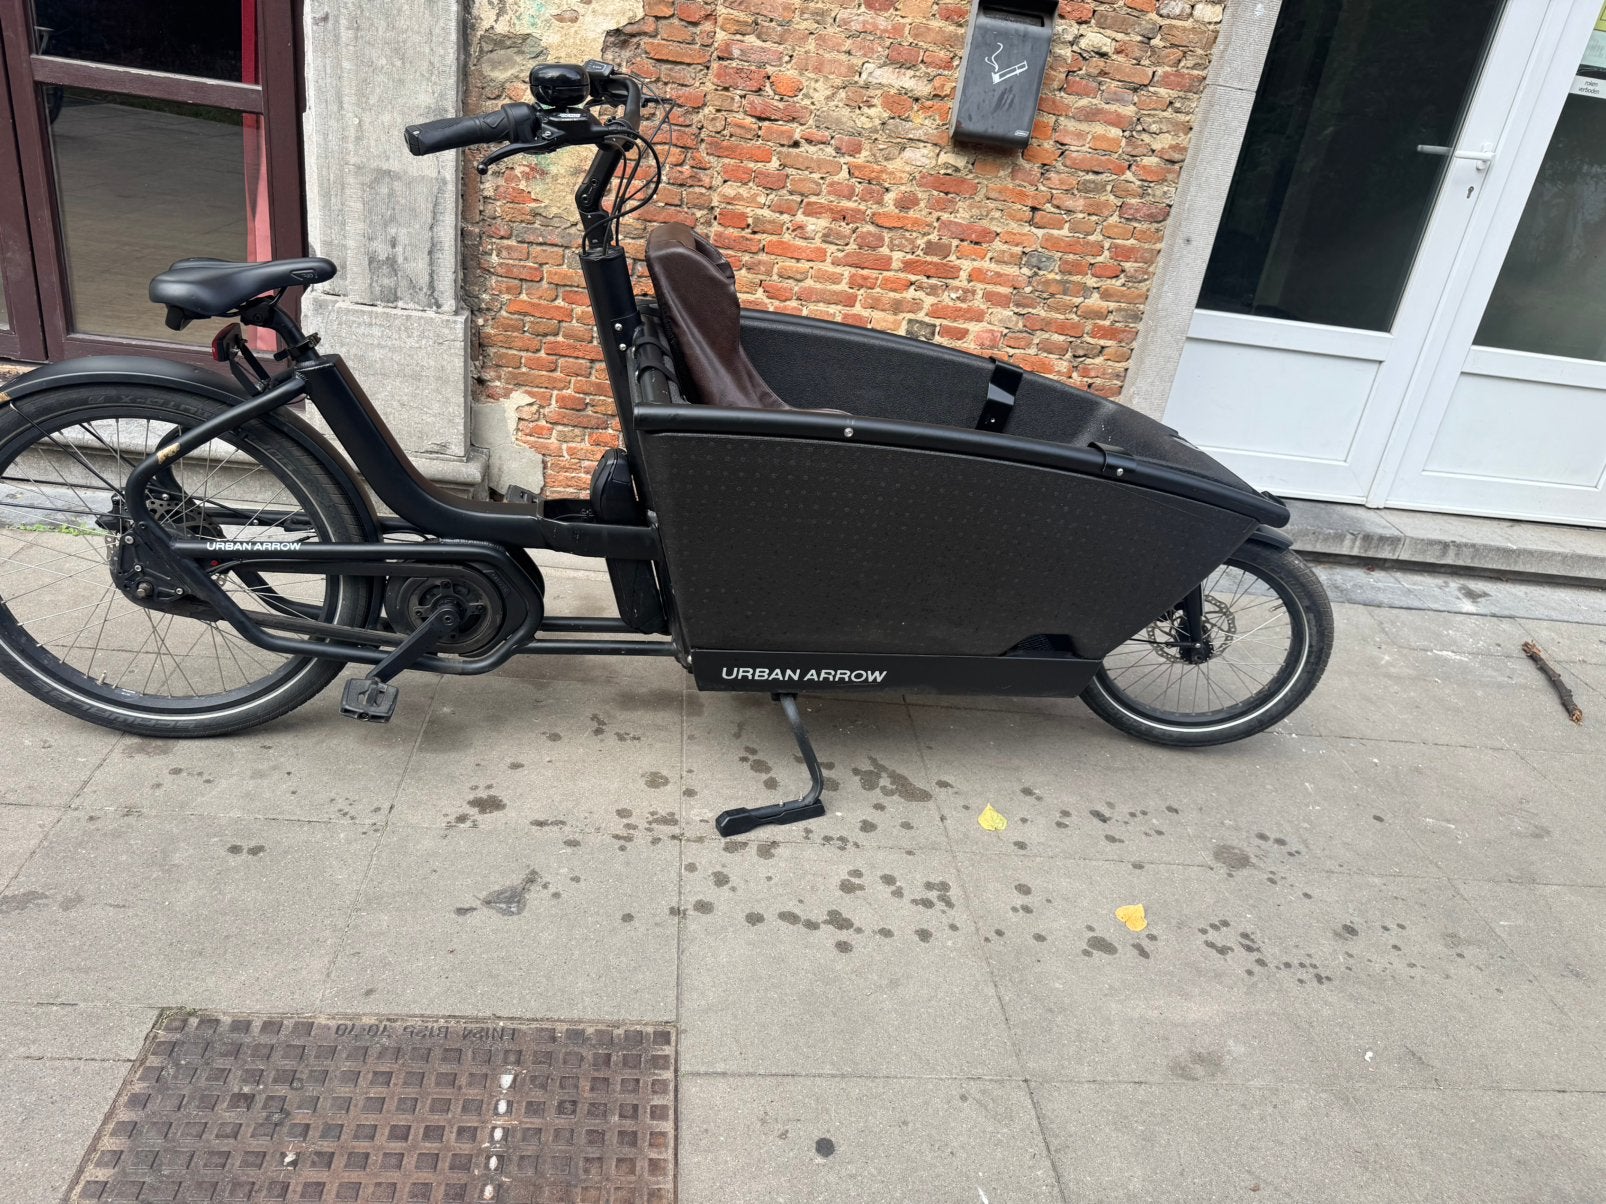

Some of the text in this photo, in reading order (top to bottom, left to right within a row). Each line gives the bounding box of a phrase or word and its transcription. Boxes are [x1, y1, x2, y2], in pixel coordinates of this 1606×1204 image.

[206, 541, 302, 551] URBAN ARROW
[721, 667, 888, 683] URBAN ARROW
[402, 1024, 449, 1040] B125
[461, 1025, 516, 1042] EN124
